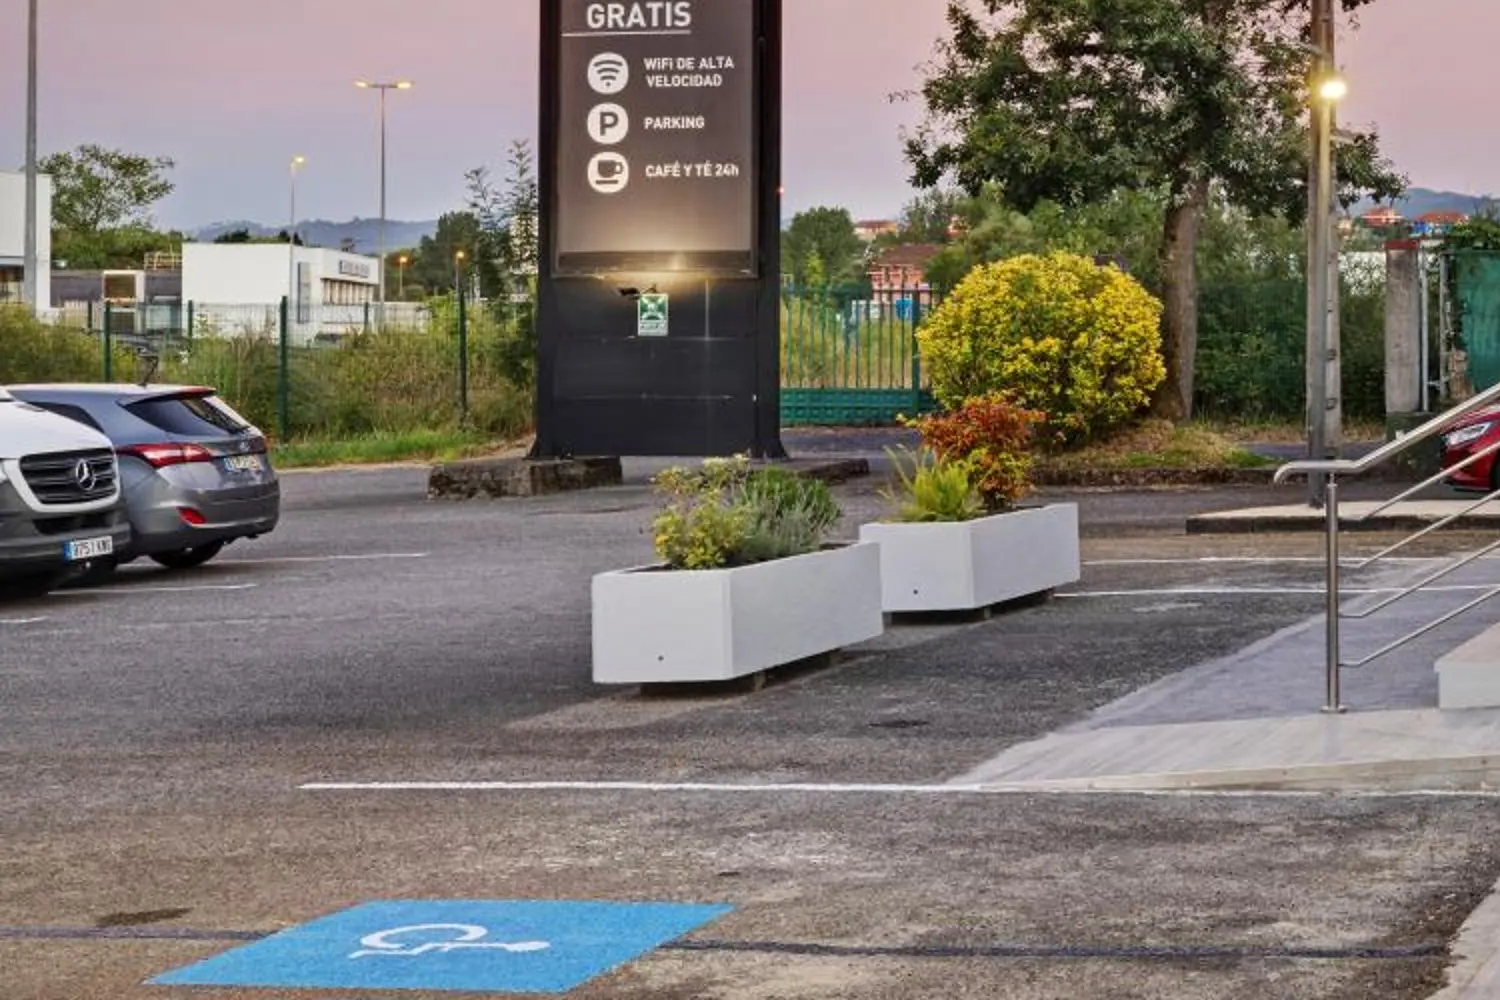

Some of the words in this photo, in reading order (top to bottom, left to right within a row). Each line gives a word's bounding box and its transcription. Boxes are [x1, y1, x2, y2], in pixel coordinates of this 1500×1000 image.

[586, 1, 692, 29] GRATIS
[676, 57, 695, 70] DE
[699, 56, 734, 69] ALTA
[645, 73, 723, 88] VELOCIDAD
[599, 111, 619, 137] P
[643, 115, 705, 130] PARKING
[645, 160, 681, 177] CAFÉ
[683, 163, 693, 177] Y
[694, 160, 712, 177] TÉ
[715, 163, 739, 177] 24h
